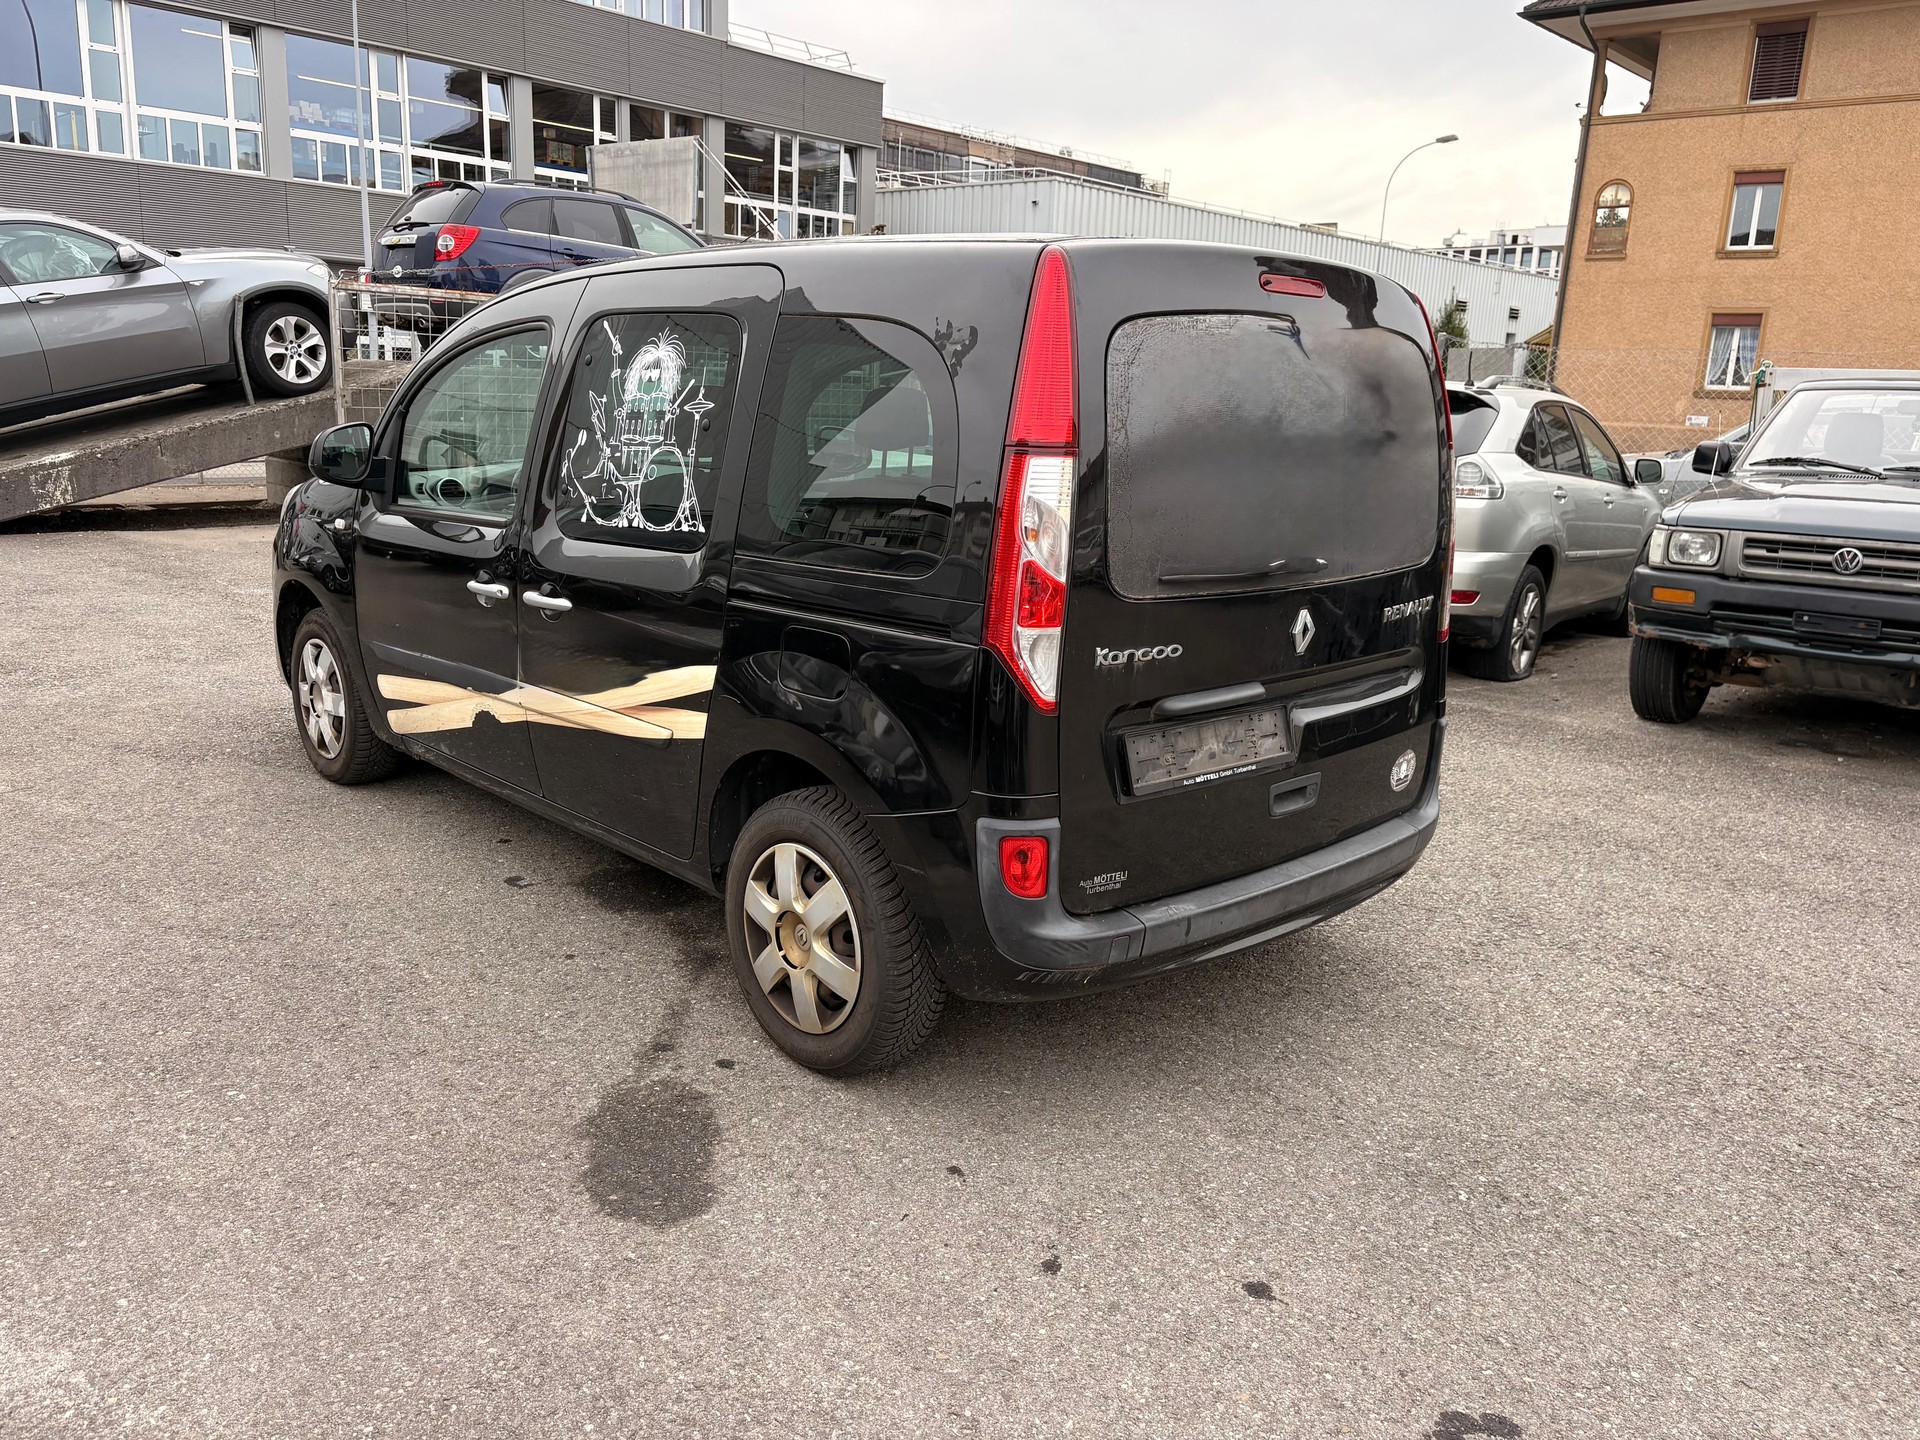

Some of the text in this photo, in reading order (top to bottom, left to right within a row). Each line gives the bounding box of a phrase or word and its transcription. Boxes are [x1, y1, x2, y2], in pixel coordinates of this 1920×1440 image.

[1383, 595, 1435, 623] RENAULT
[1079, 871, 1127, 888] Auto MÖTTELI
[1086, 882, 1121, 894] Turbenthal
